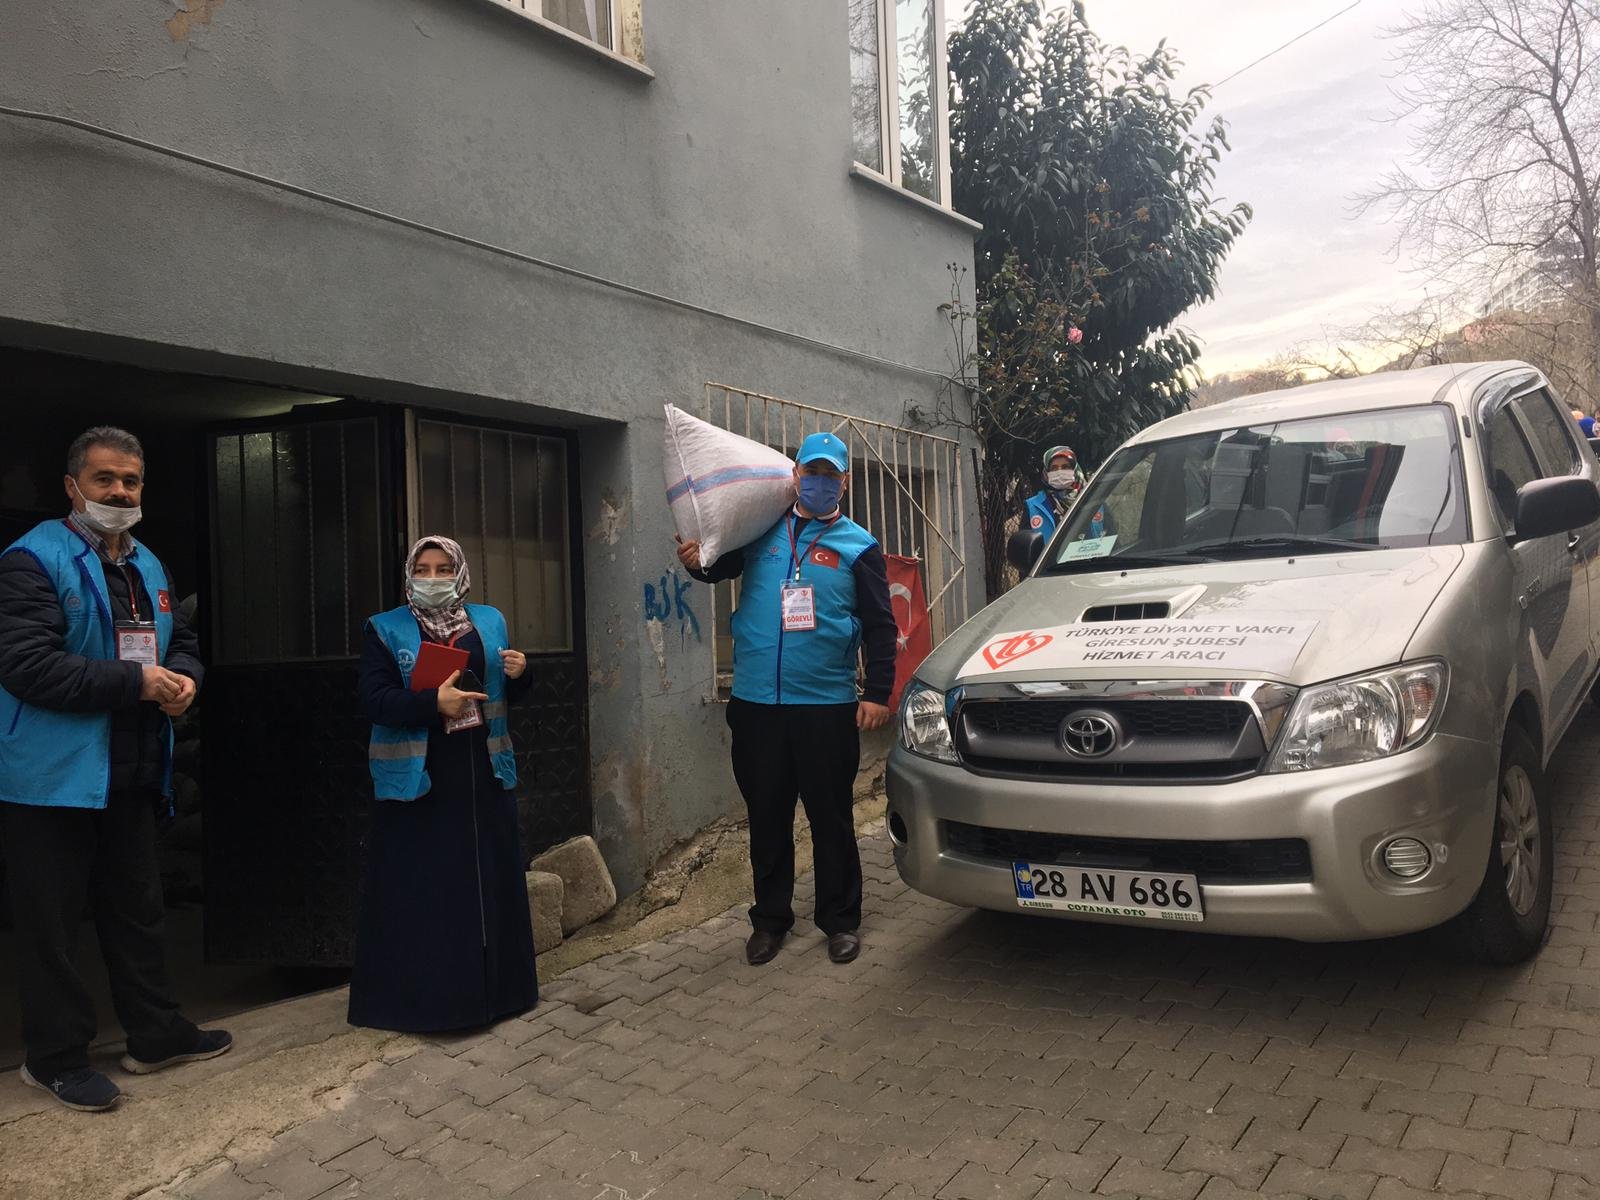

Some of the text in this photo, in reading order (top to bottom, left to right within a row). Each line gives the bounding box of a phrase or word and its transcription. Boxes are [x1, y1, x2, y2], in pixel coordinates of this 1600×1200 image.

[1065, 623, 1296, 638] TÜRKİYE DİYANET VAKFI
[1085, 636, 1247, 649] GİRESUN ŞUBESİ
[1082, 649, 1226, 661] HİZMET ARACI
[1020, 883, 1032, 892] TR
[1031, 869, 1193, 908] 28 AV 686
[1067, 903, 1146, 917] COTANAK OTO
